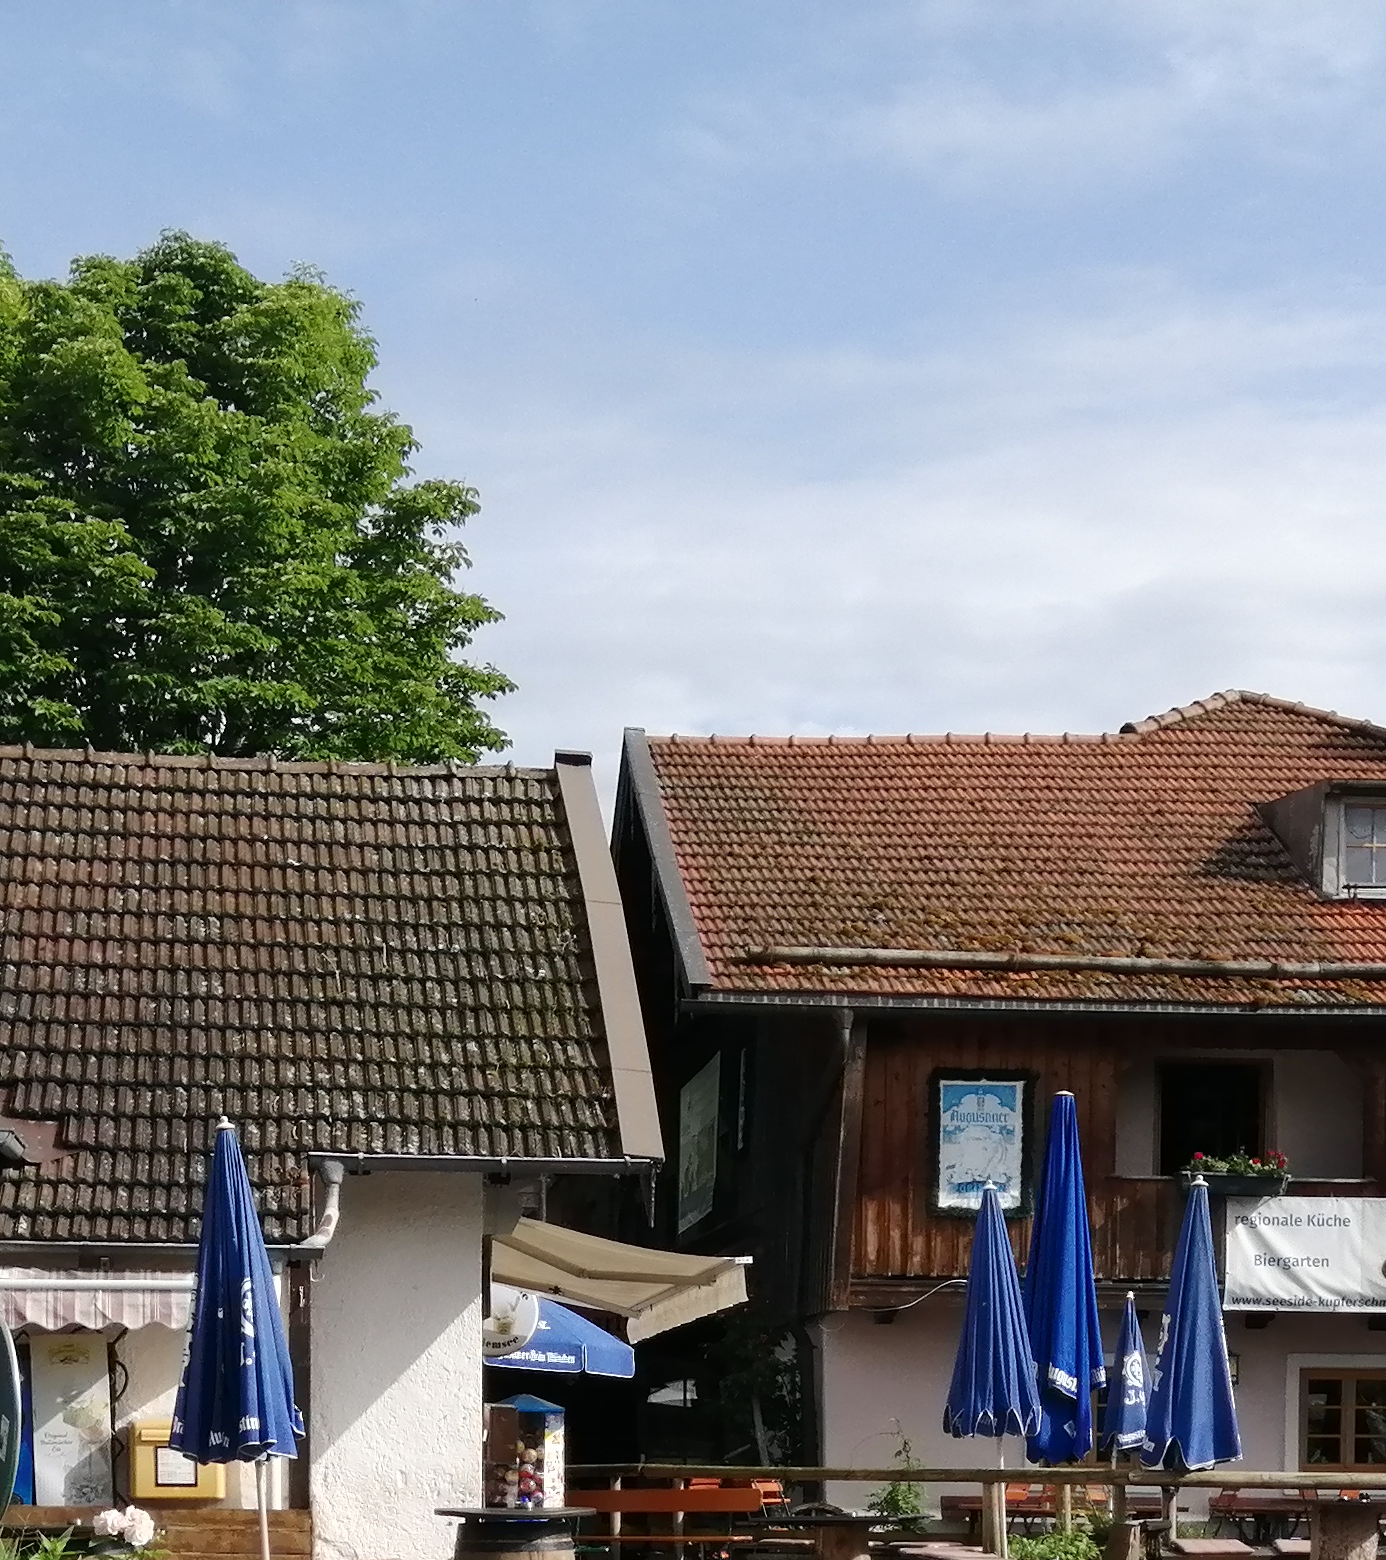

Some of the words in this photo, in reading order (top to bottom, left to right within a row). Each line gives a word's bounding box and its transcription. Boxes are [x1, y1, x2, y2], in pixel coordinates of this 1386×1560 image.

[1234, 1213, 1302, 1229] regionale
[1307, 1213, 1351, 1227] Küche
[1253, 1253, 1330, 1270] Biergarten
